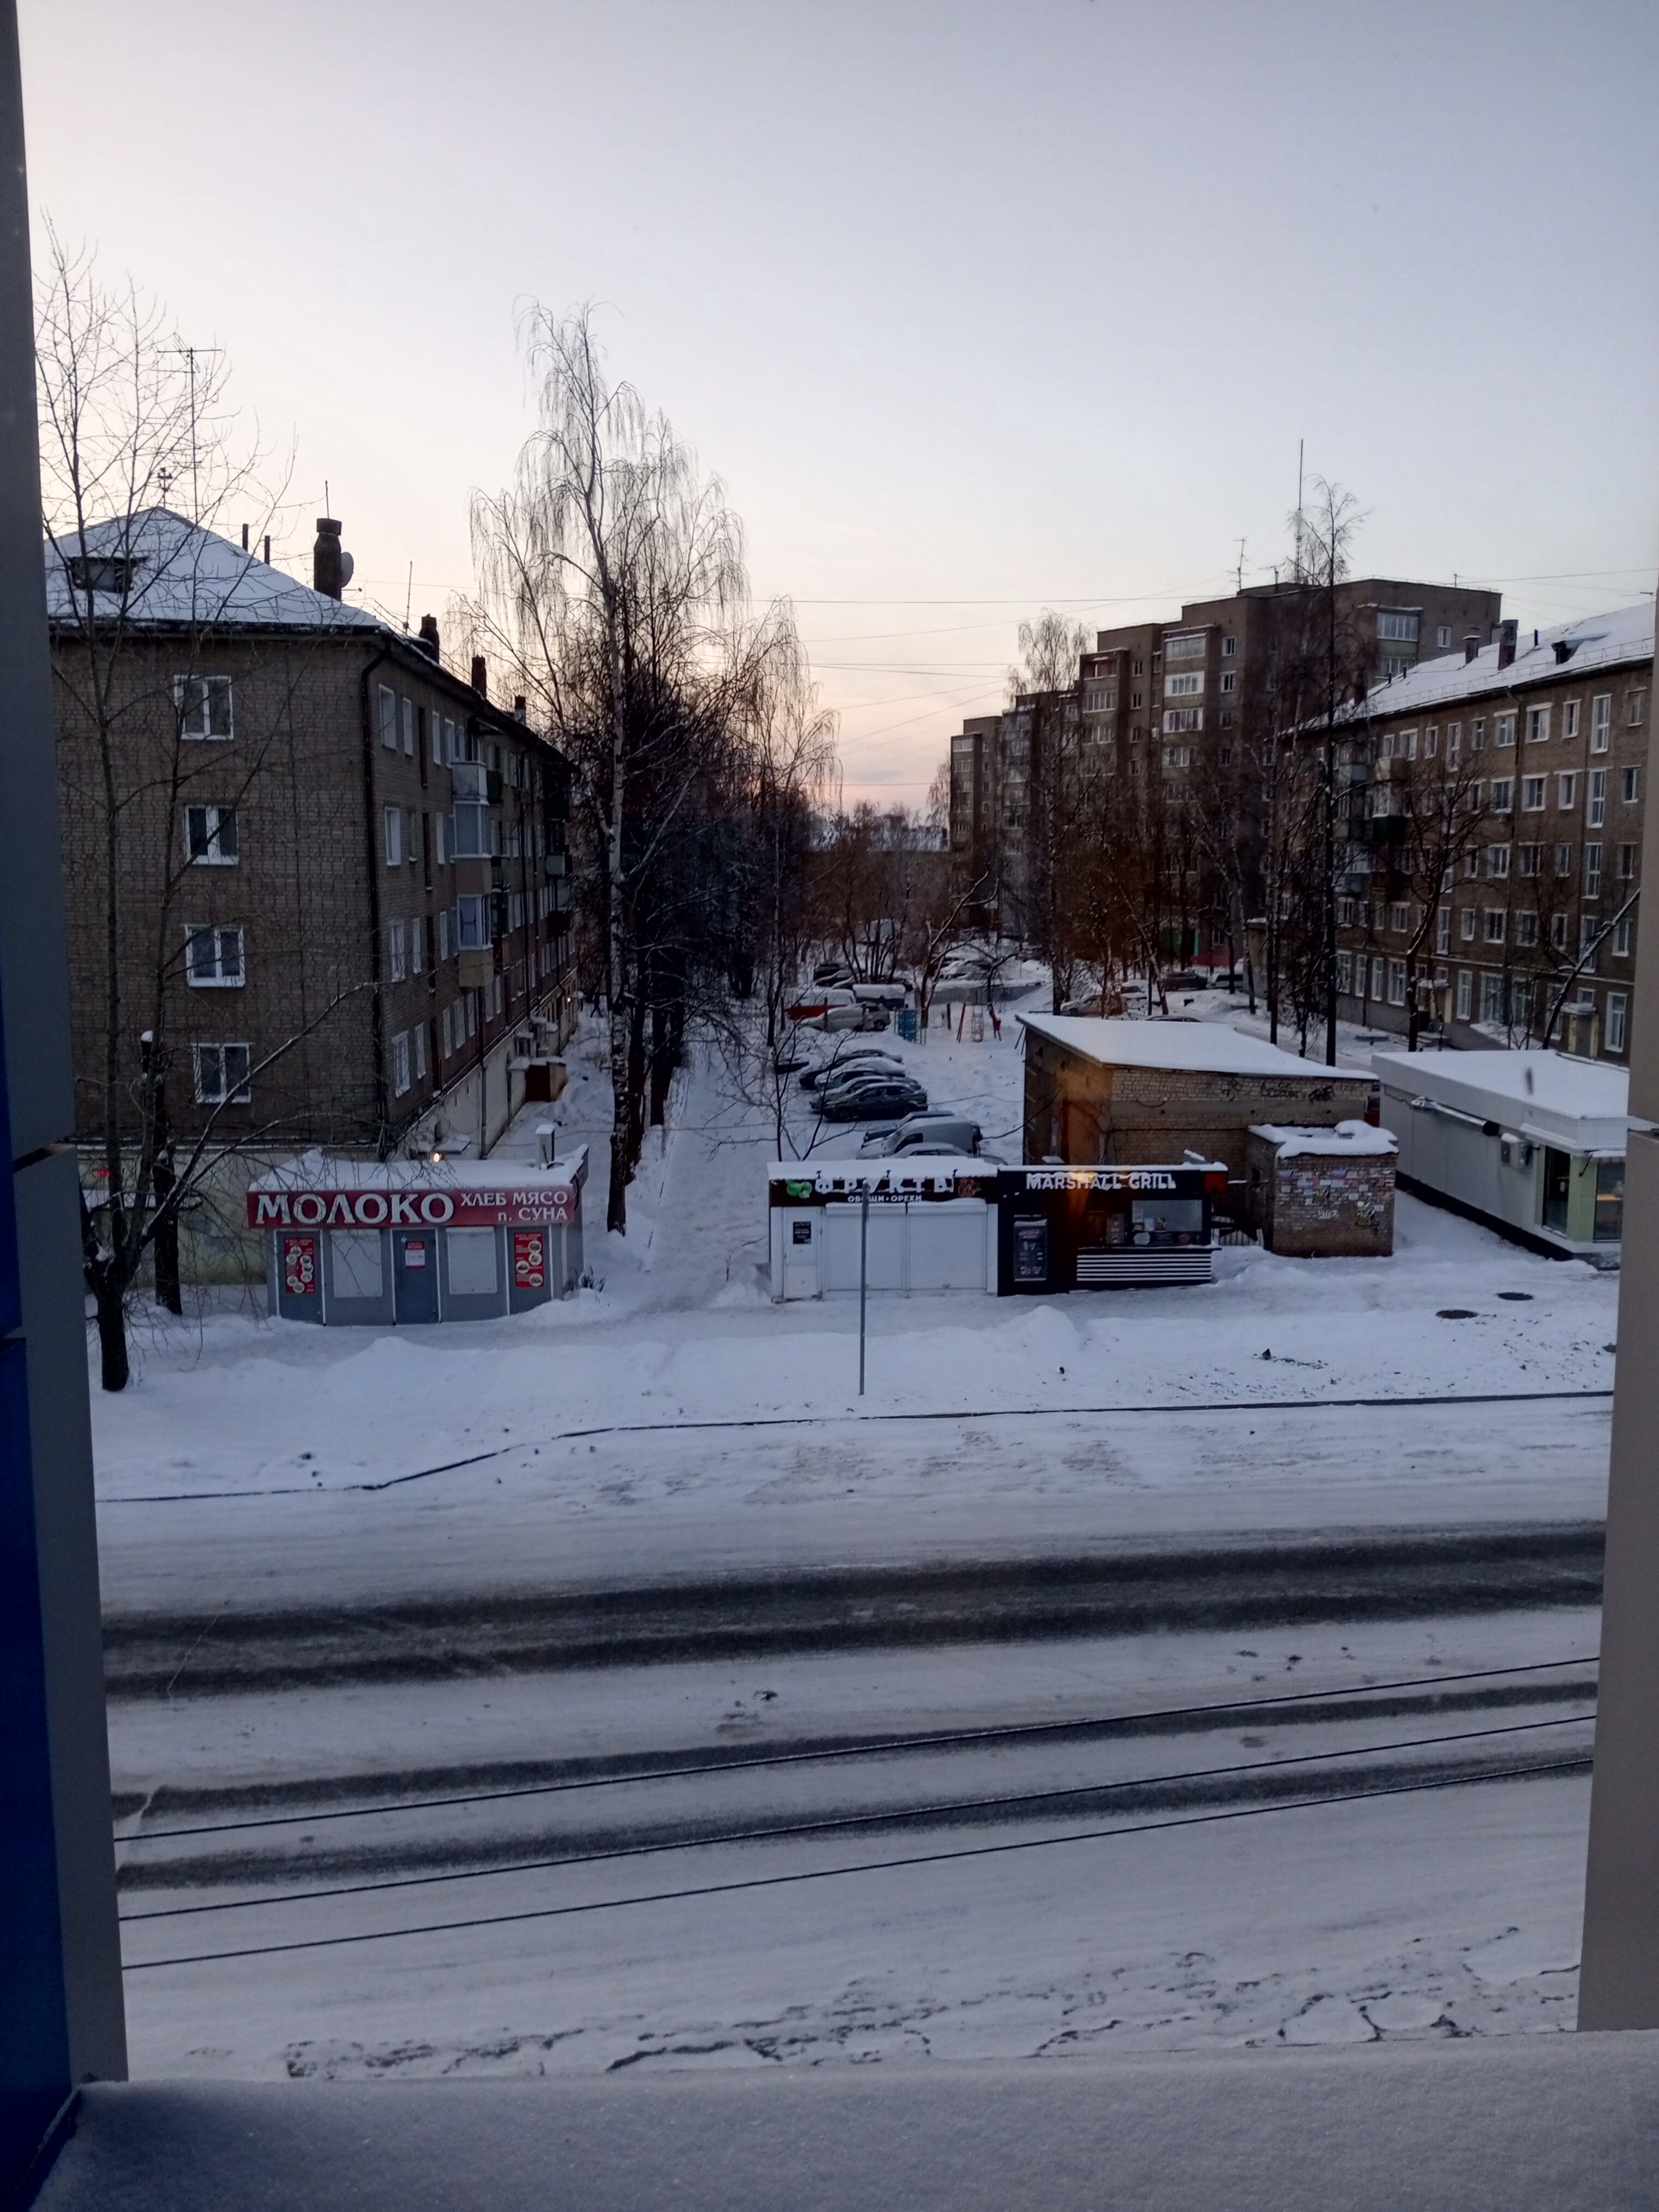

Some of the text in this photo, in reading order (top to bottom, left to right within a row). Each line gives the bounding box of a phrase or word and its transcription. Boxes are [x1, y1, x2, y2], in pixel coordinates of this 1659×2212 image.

[1026, 1172, 1176, 1190] MARSHALL GRILL
[460, 1190, 568, 1207] ХЛЕБ МЯСО
[847, 1194, 922, 1203] ОВЩИ ОРЕХИ
[255, 1193, 454, 1224] МОЛОКО
[518, 1207, 568, 1221] СУНА
